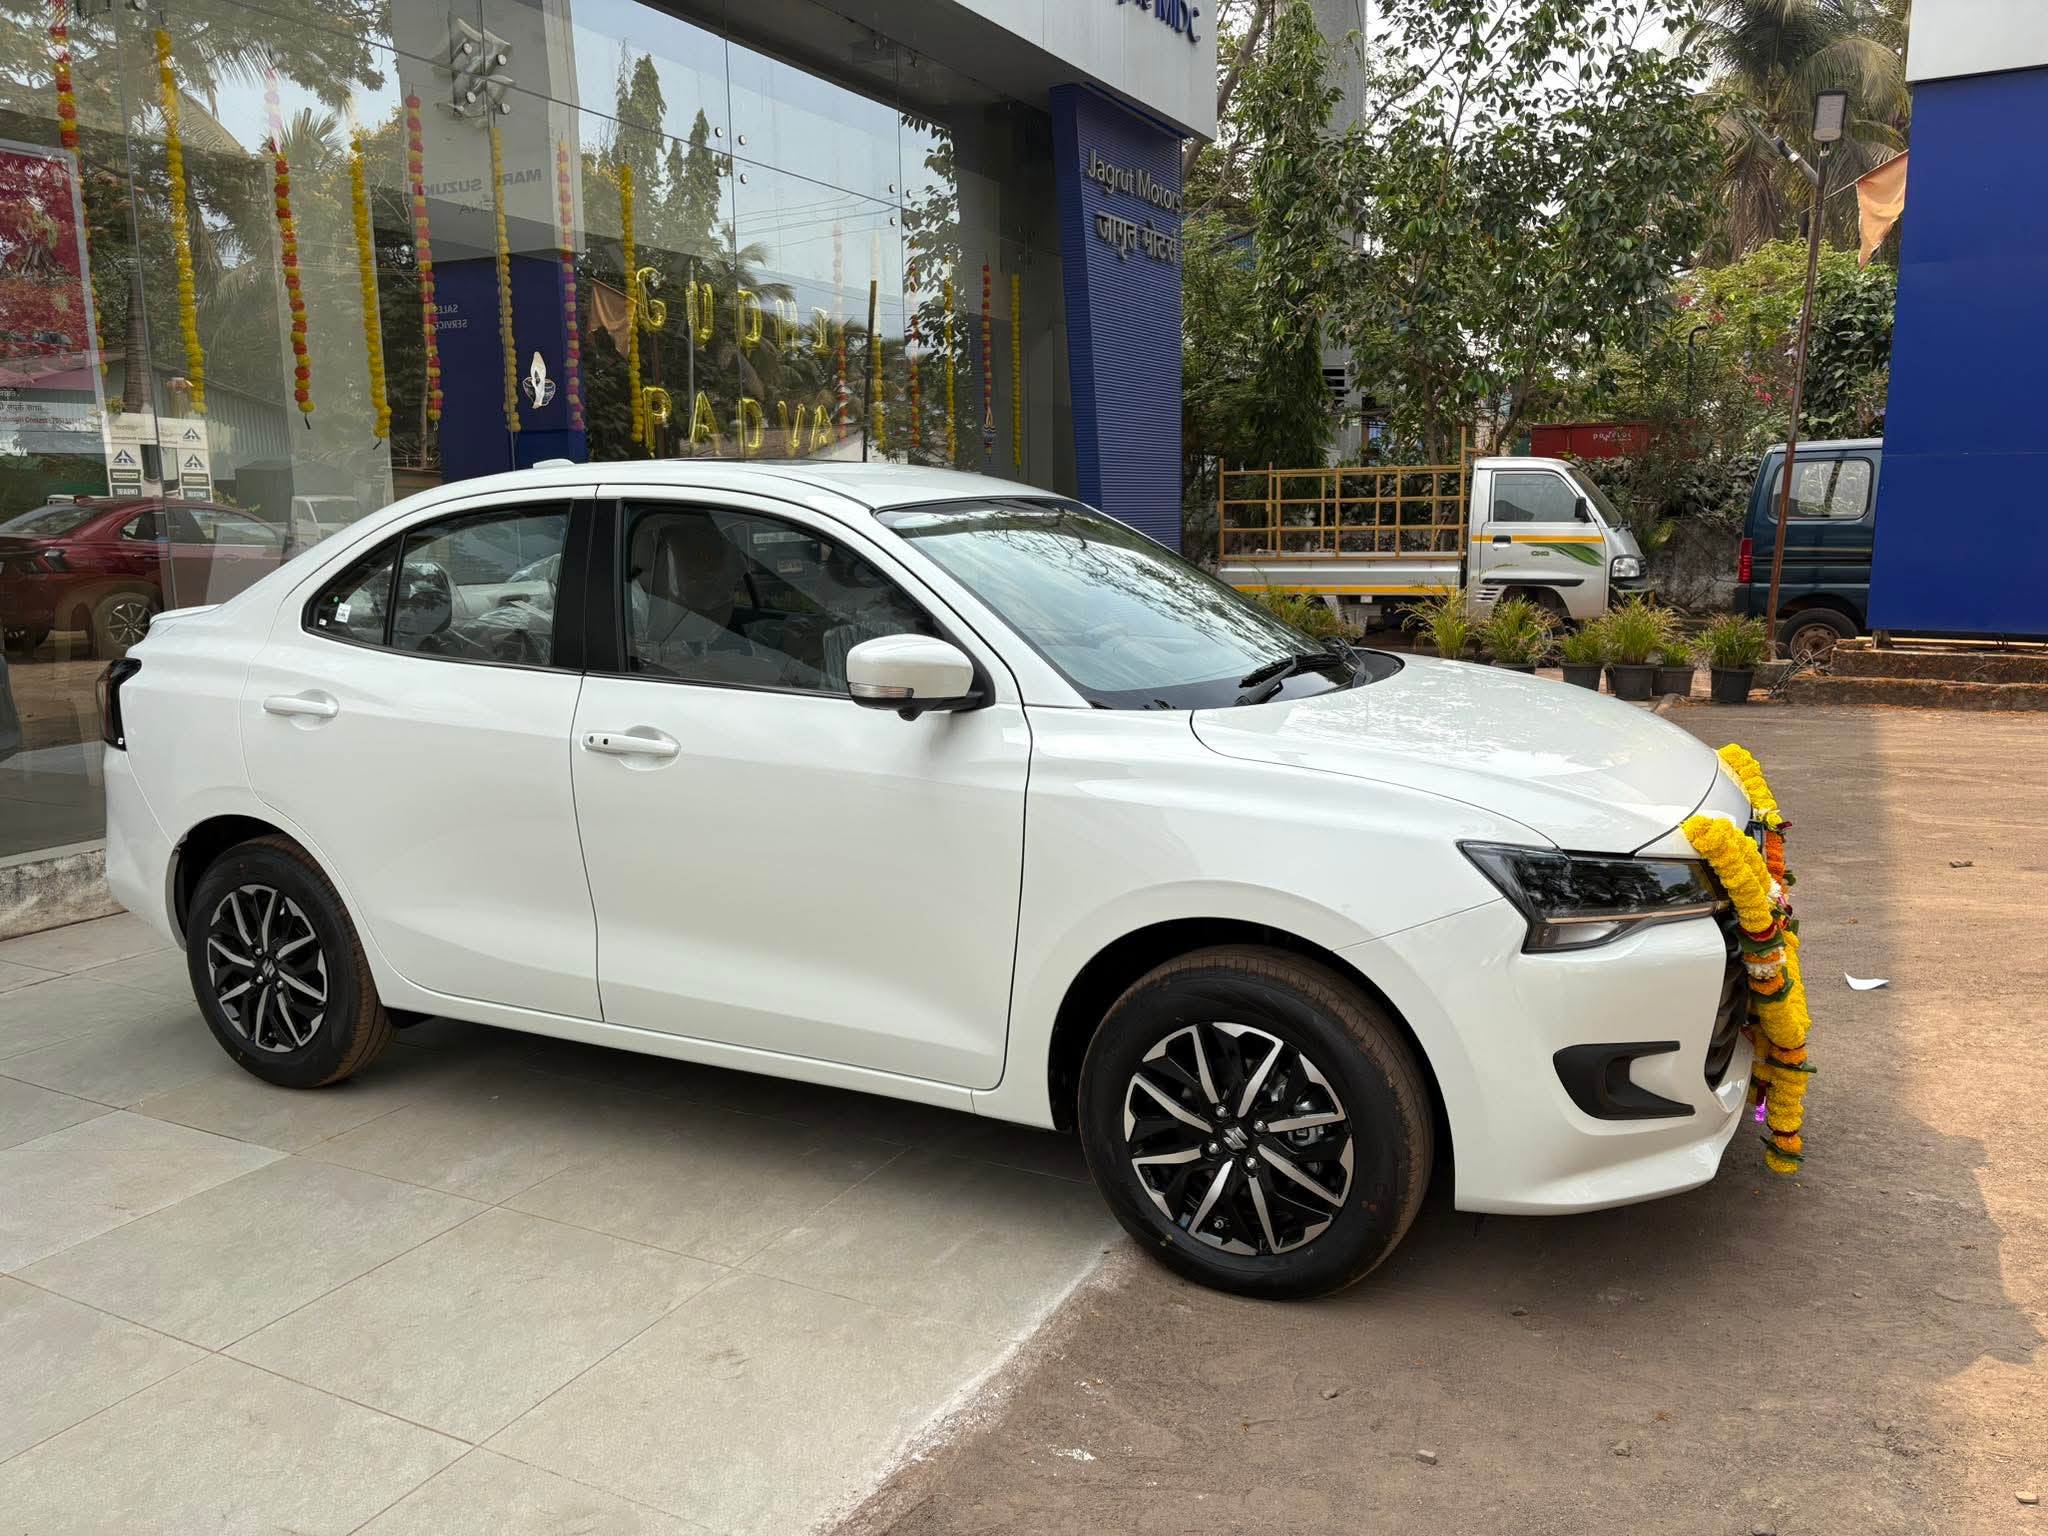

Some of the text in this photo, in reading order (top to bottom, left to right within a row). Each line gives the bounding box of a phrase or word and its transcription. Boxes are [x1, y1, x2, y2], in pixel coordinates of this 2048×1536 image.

[1088, 149, 1183, 213] Jagrut Motors
[1096, 208, 1138, 261] जागृत
[642, 386, 836, 457] PADVA
